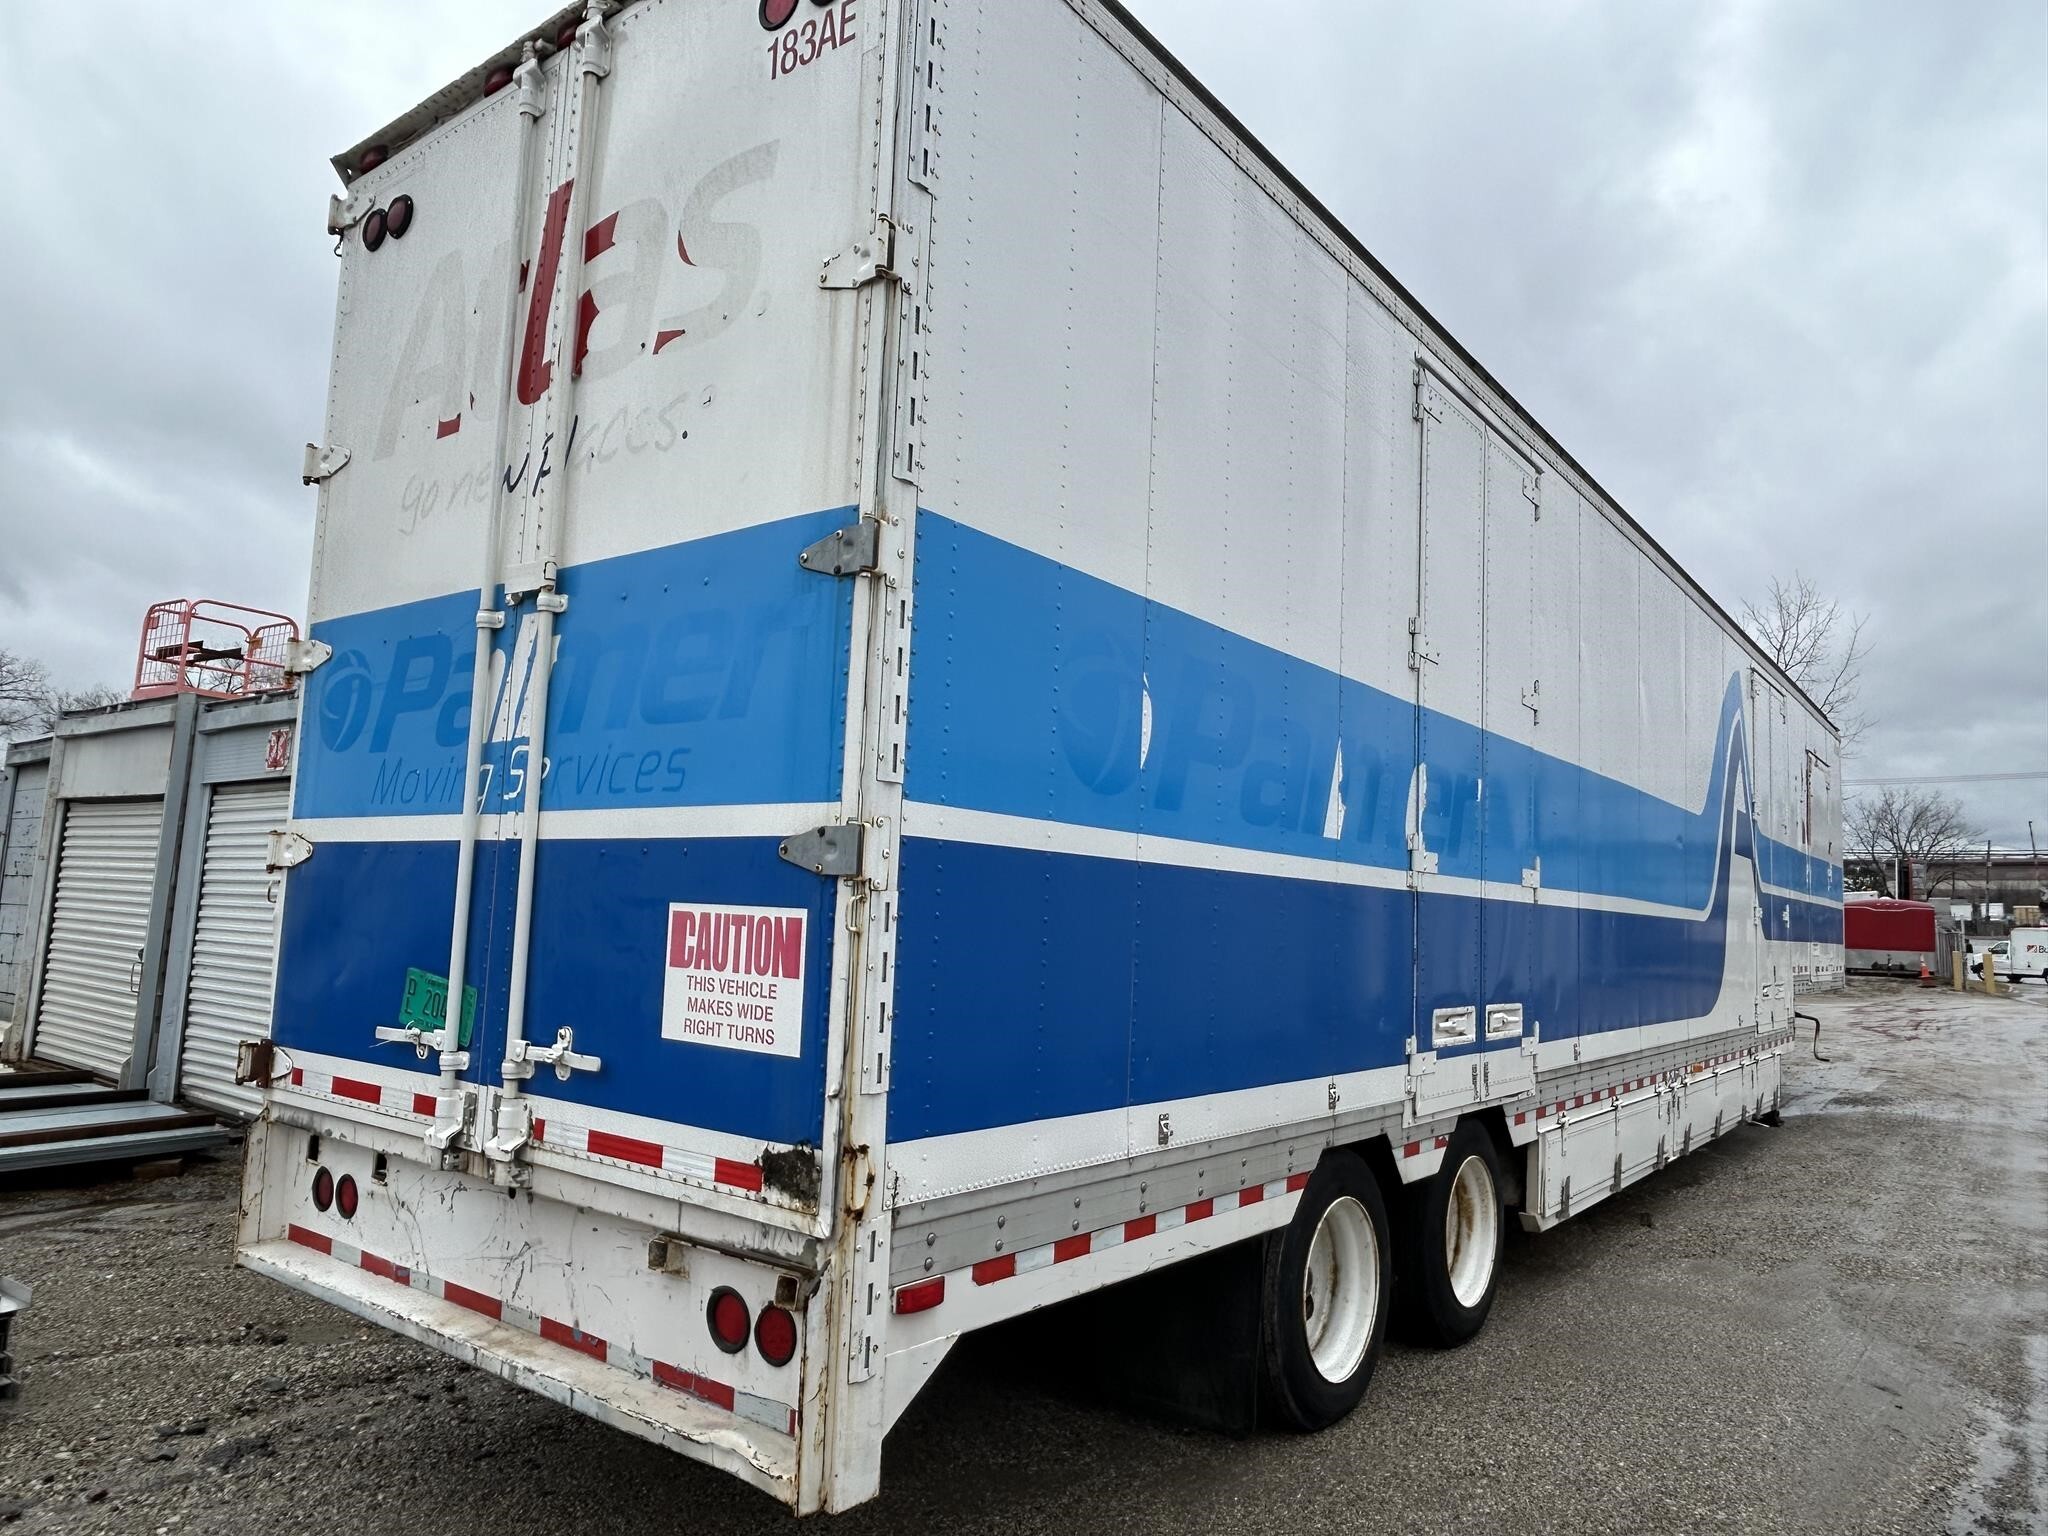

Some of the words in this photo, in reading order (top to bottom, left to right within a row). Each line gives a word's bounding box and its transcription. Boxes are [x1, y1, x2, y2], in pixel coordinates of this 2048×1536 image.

[766, 0, 857, 80] 183AE
[669, 910, 803, 980] CAUTION
[686, 975, 715, 993] THIS
[719, 978, 778, 1000] VEHICLE
[687, 996, 733, 1017] MAKES
[737, 1003, 774, 1022] WIDE
[683, 1018, 724, 1039] RIGHT
[727, 1024, 775, 1045] TURNS
